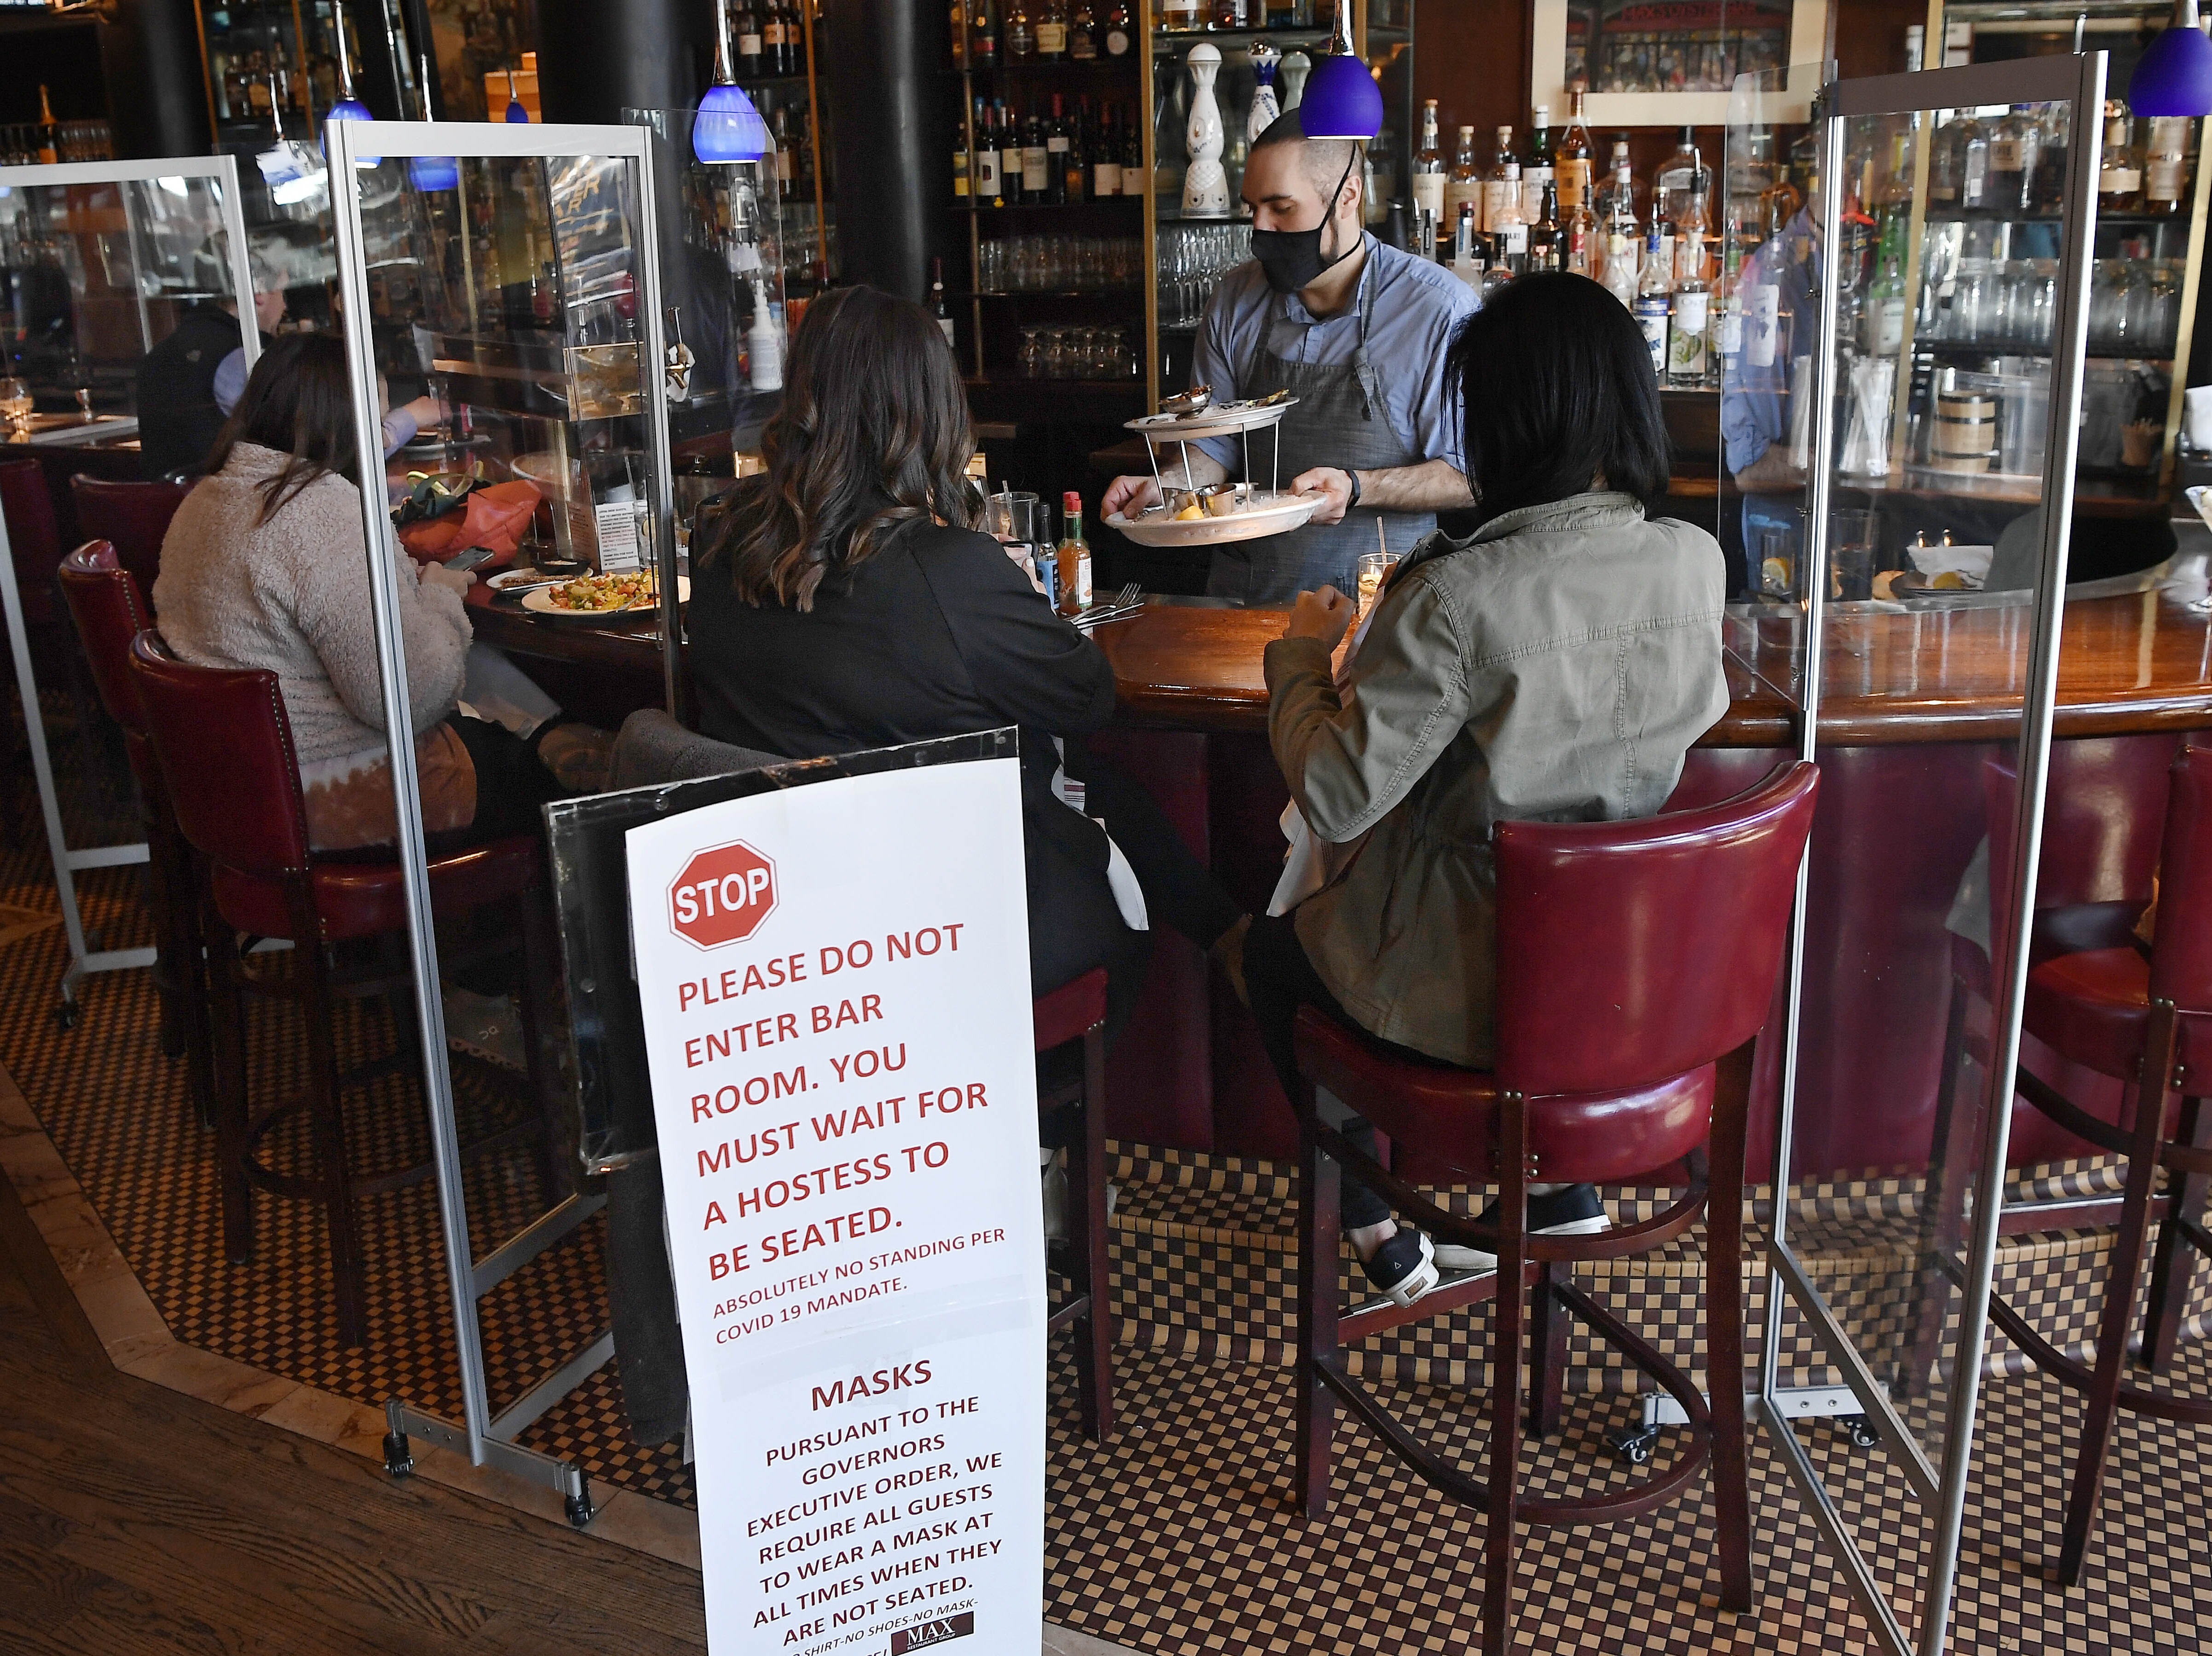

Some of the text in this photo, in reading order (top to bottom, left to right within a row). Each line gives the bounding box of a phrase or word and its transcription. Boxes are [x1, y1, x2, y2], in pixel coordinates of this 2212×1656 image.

[675, 867, 770, 924] STOP
[679, 923, 963, 1012] PLEASE DO NOT
[685, 995, 883, 1068] ENTER BAR
[691, 1043, 905, 1123] ROOM. YOU
[697, 1083, 988, 1177] MUST WAIT FOR
[704, 1142, 948, 1230] A HOSTESS TO
[709, 1207, 902, 1281] BE SEATED.
[714, 1229, 1004, 1319] ABSOLUTELY NO STANDING PER
[717, 1277, 907, 1344] COVID 19 MANDATE.
[812, 1360, 931, 1411] MASKS
[767, 1397, 979, 1466] PURSUANT TO THE
[803, 1434, 945, 1484] GOVERNORS
[748, 1452, 1002, 1537] EXECUTIVE ORDER, WE
[760, 1484, 992, 1564] REQUIRE ALL GUESTS
[754, 1539, 1002, 1628] ALL TIMES WHEN THEY
[760, 1512, 993, 1593] TO WEAR A MASK AT
[783, 1577, 972, 1646] ARE NOT SEATED.
[867, 1610, 933, 1636] SHOES-NO
[937, 1598, 978, 1616] MASK-
[906, 1617, 956, 1646] MAX
[907, 1633, 956, 1650] RESTAURANT GROUP
